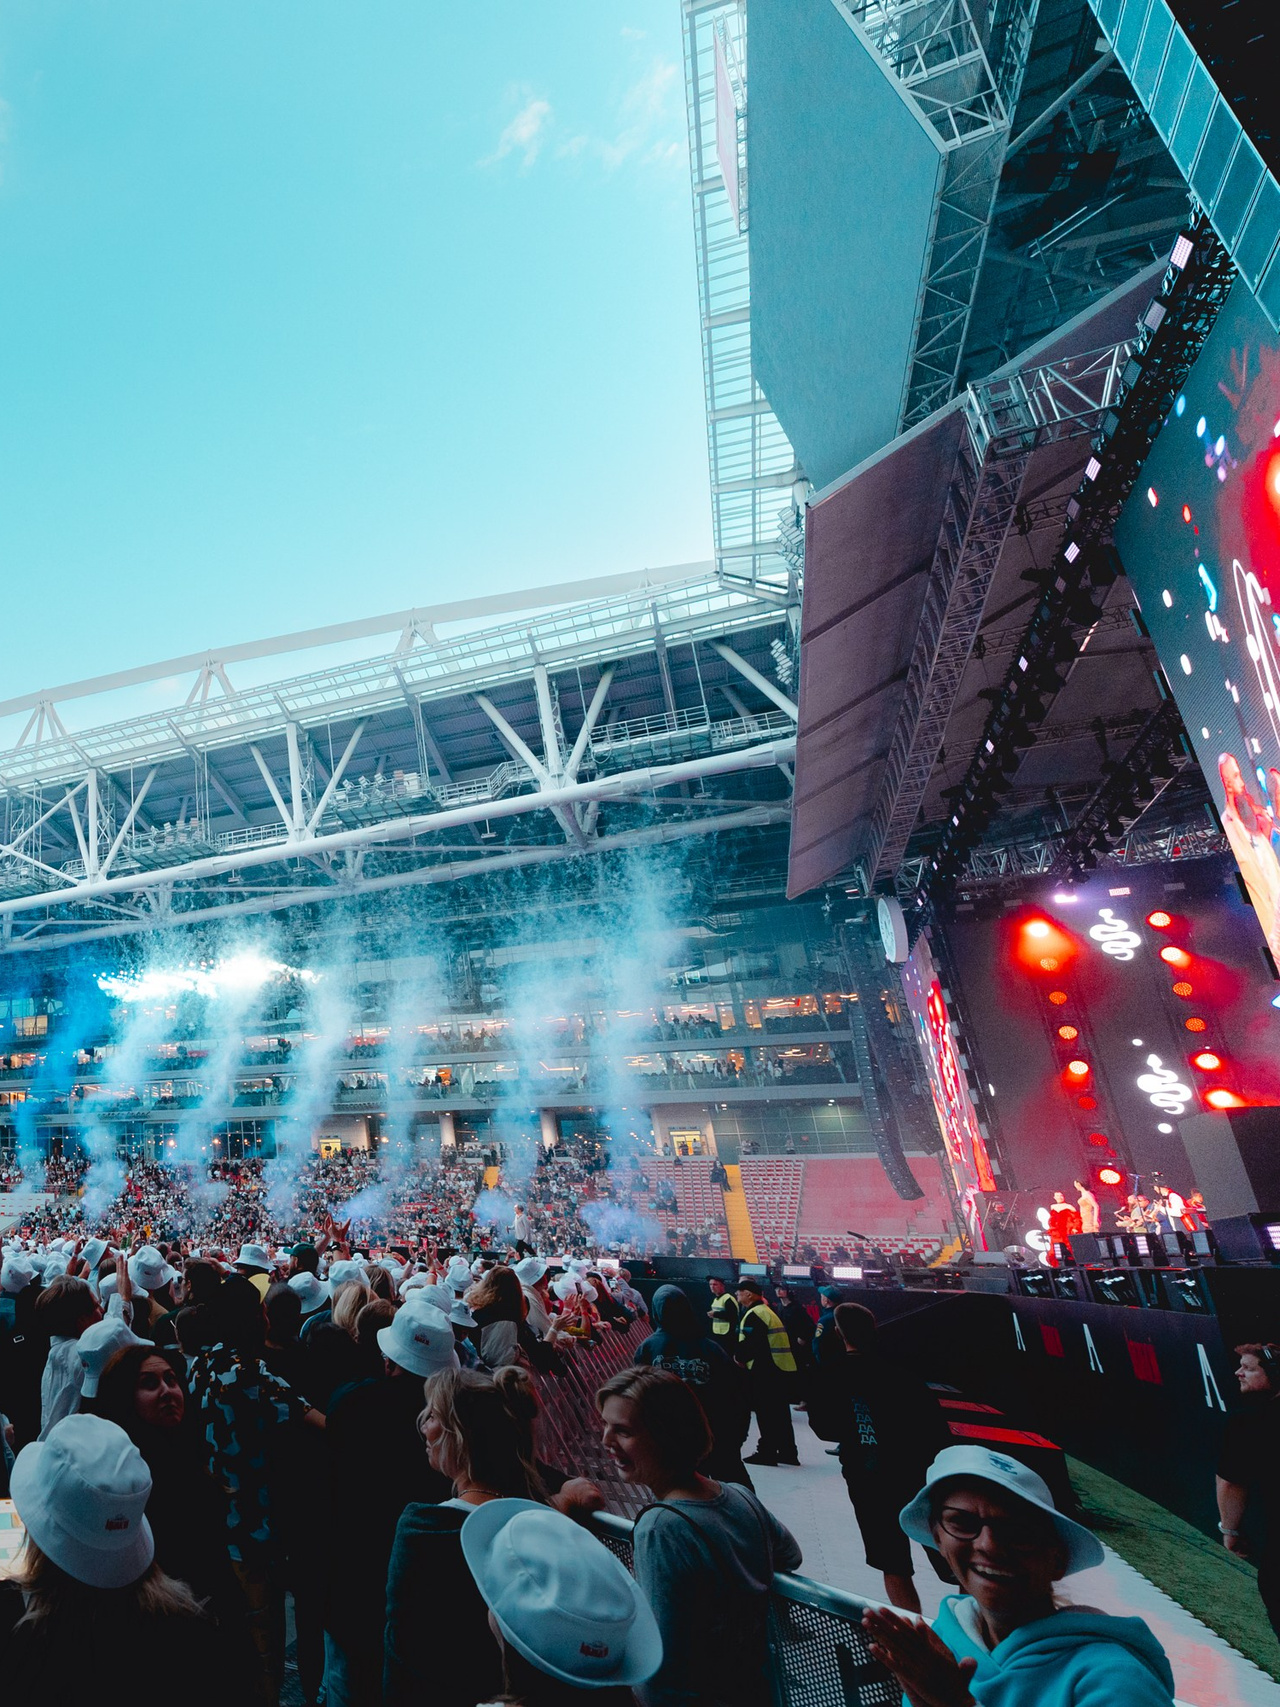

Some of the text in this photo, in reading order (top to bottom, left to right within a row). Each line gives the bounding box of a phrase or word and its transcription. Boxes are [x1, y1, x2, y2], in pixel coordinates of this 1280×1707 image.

[662, 1362, 705, 1373] DECOR
[858, 1423, 876, 1435] ДА
[860, 1434, 878, 1446] ДА
